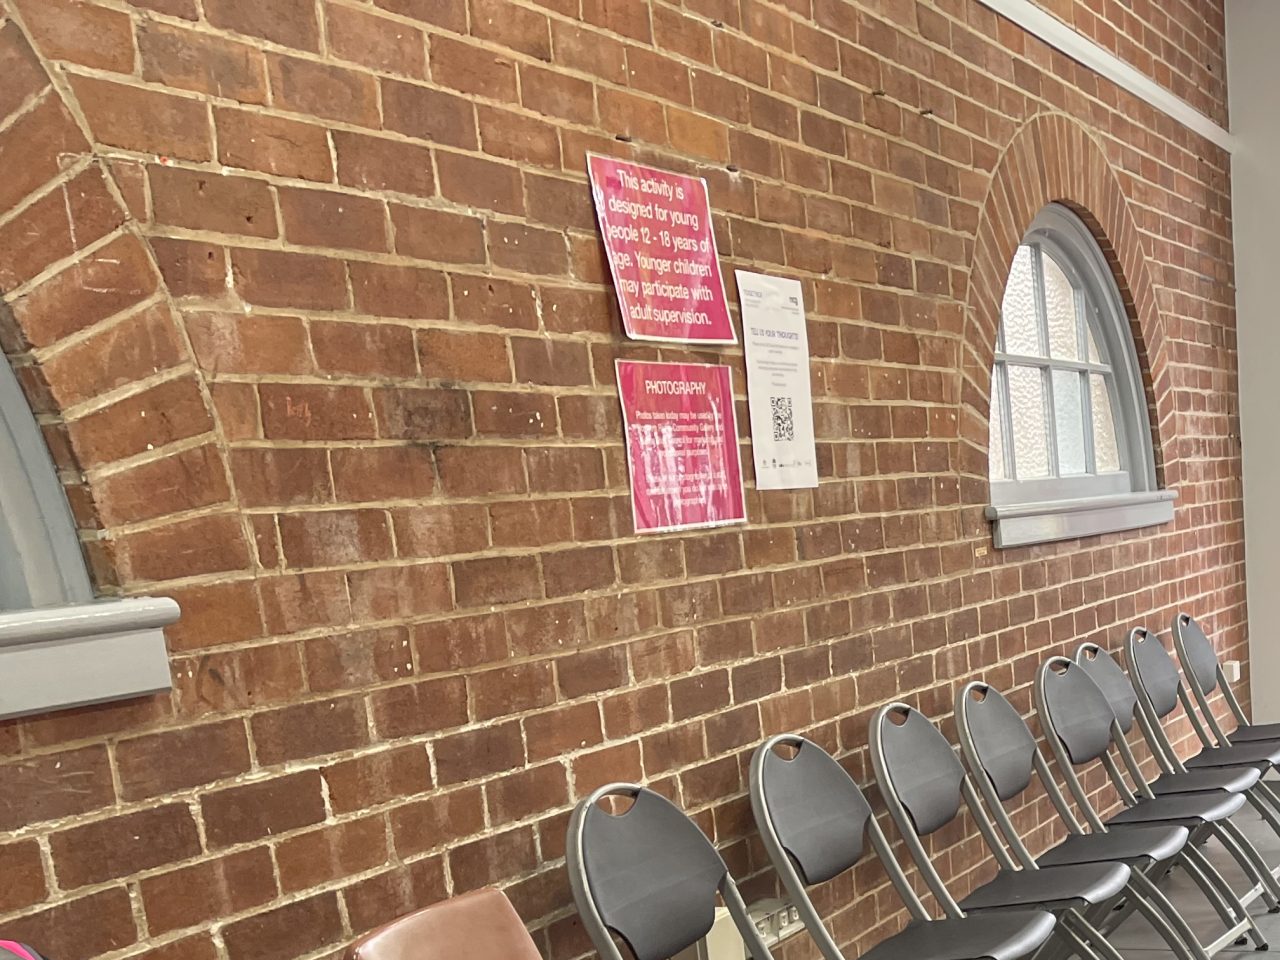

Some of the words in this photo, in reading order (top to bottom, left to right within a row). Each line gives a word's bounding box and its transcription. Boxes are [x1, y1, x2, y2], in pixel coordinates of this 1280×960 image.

[617, 169, 639, 190] This
[641, 178, 673, 201] activity
[675, 184, 684, 199] is
[609, 198, 653, 220] designed
[654, 204, 668, 219] for
[669, 211, 699, 230] young
[606, 223, 638, 242] people
[640, 227, 651, 244] 12
[660, 231, 670, 247] 18
[671, 235, 699, 252] years
[700, 237, 710, 252] of
[612, 251, 633, 269] age.
[635, 250, 671, 275] Younger
[673, 260, 712, 277] children
[619, 279, 639, 296] may
[641, 281, 690, 301] participate
[690, 286, 713, 301] with
[629, 305, 653, 321] adult
[653, 308, 712, 325] supervision.
[645, 380, 707, 395] PHOTOGRAPHY
